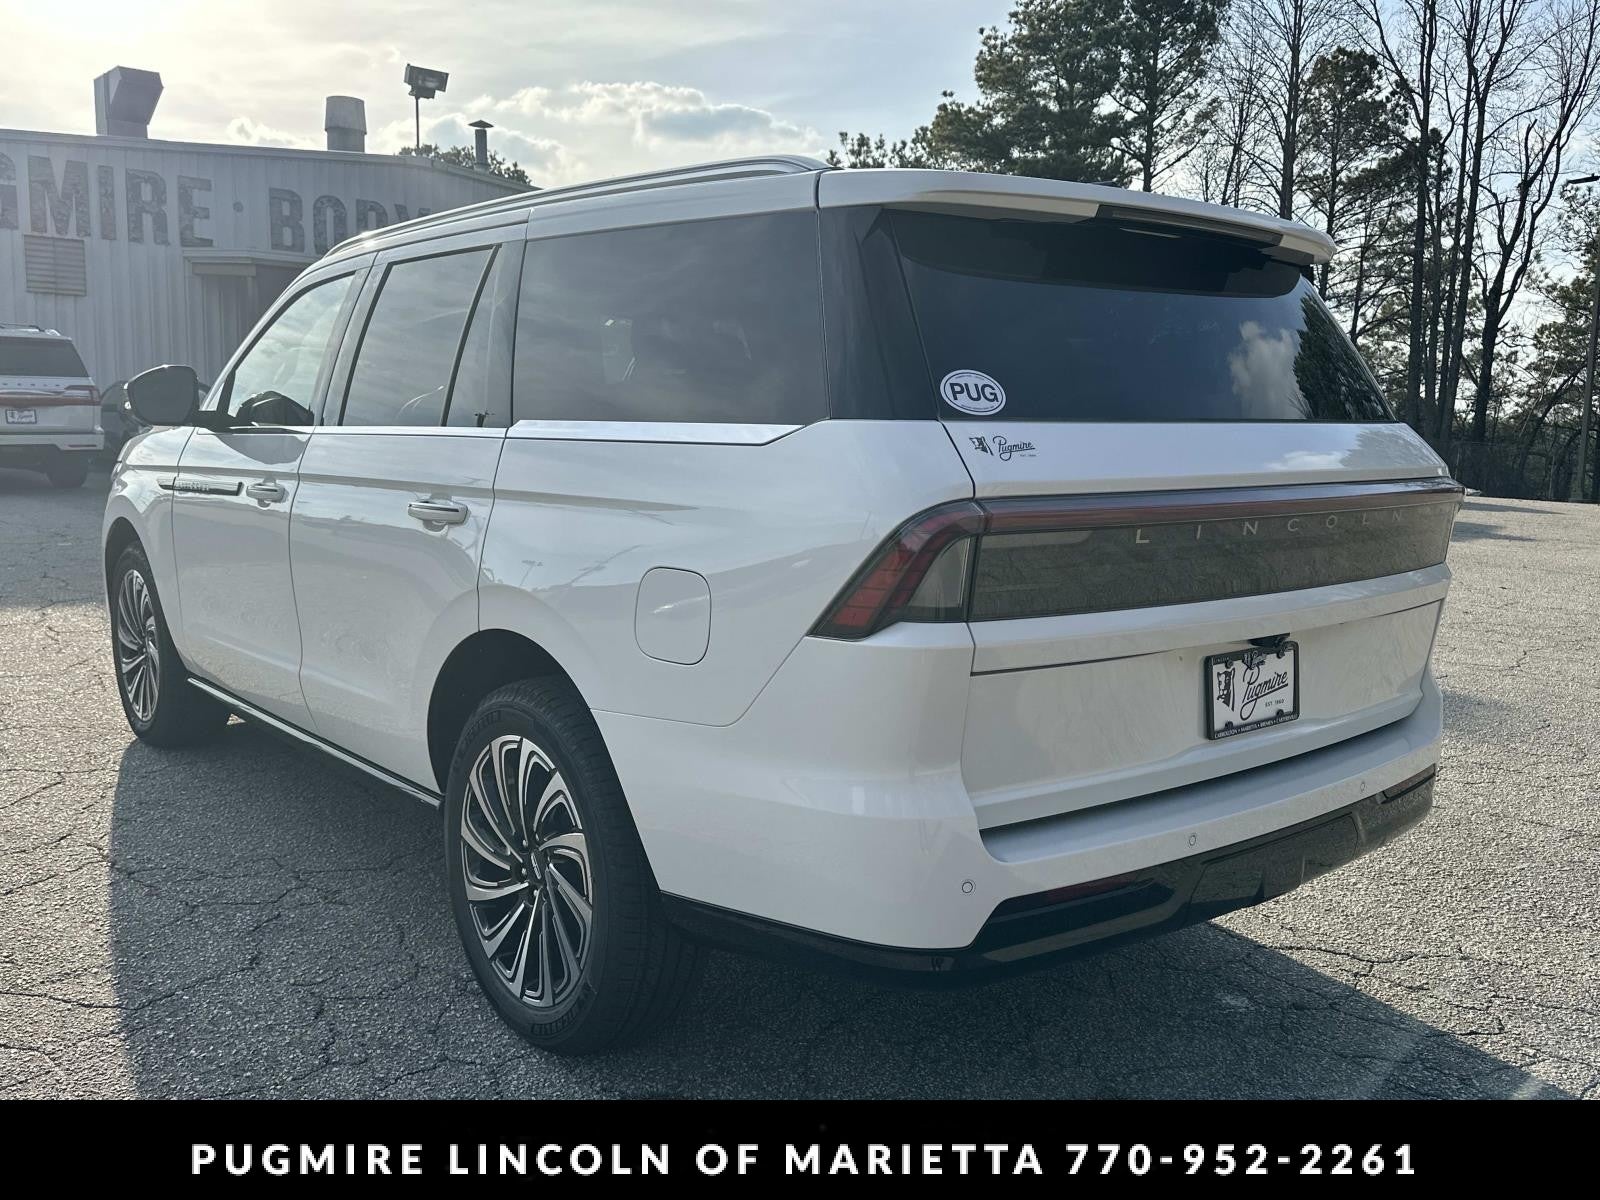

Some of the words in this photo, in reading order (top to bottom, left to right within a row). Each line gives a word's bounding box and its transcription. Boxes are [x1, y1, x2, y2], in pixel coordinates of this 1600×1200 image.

[269, 187, 430, 256] BOD
[949, 382, 1000, 403] PUG
[992, 435, 1036, 462] Pugmire
[1135, 510, 1401, 544] LINCOLN
[1240, 663, 1289, 721] Pugmire
